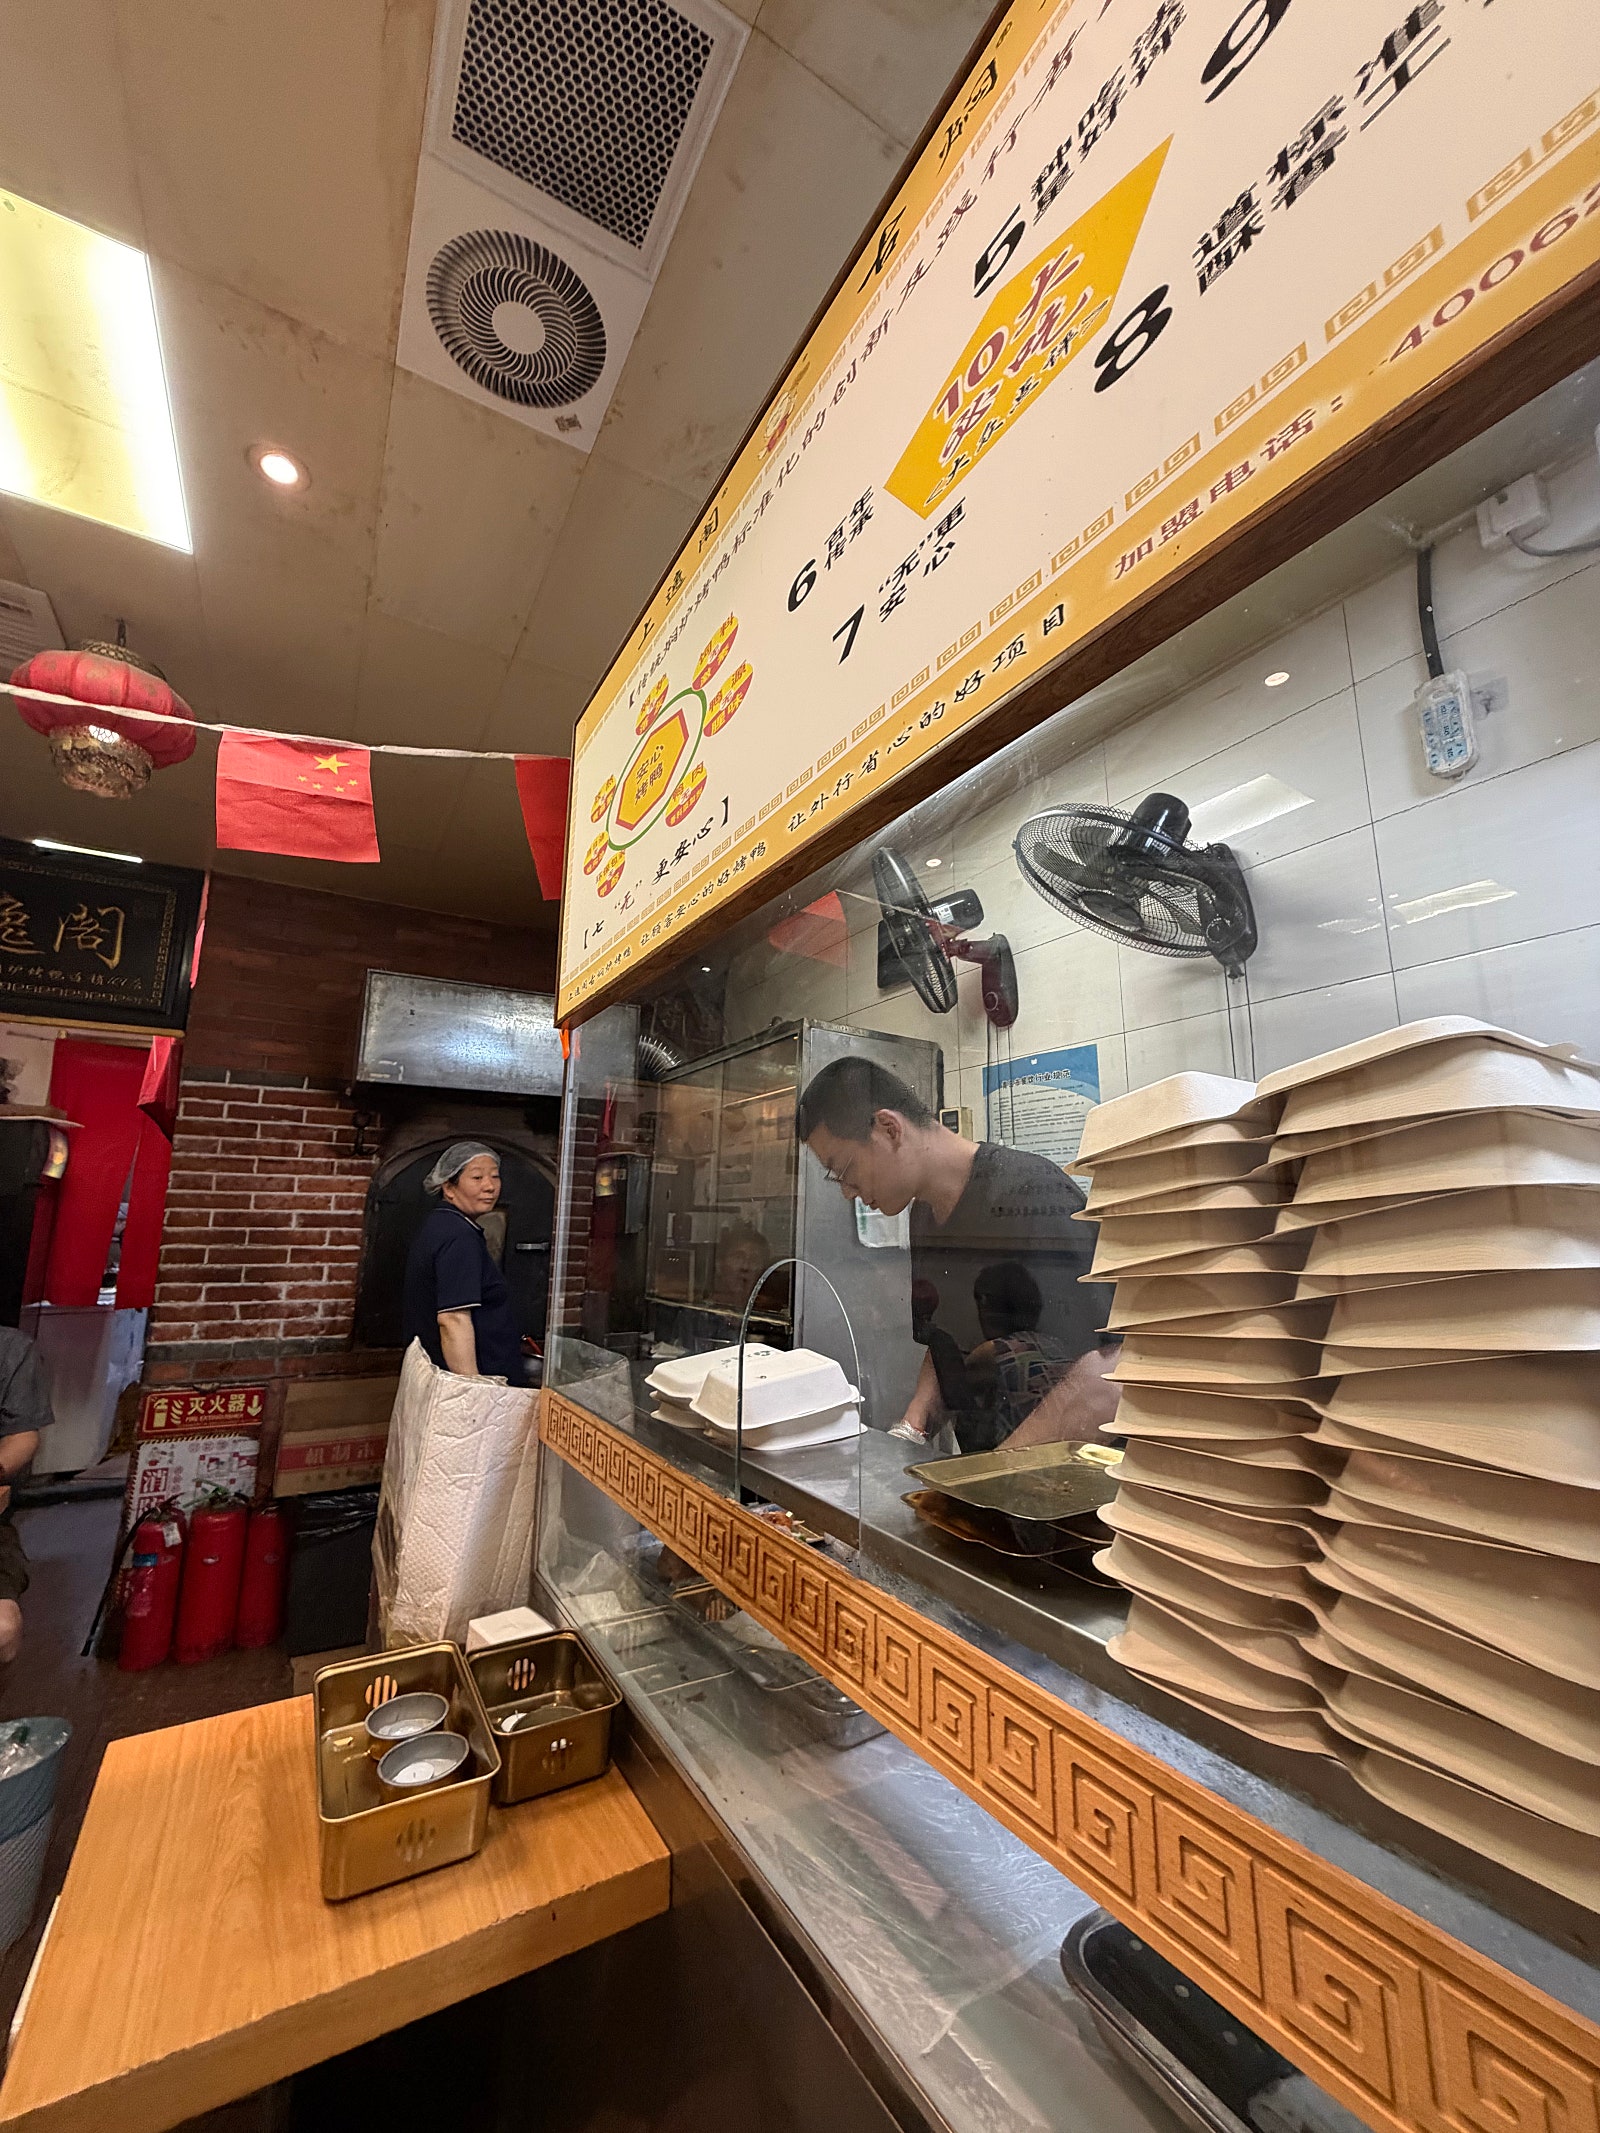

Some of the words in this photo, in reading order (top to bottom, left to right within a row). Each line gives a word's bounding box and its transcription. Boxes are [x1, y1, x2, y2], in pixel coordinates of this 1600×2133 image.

[1200, 0, 1291, 104] 9
[1197, 0, 1495, 296] 酥香工
[974, 203, 1026, 298] 5
[940, 287, 1093, 466] 必吃
[1094, 284, 1173, 393] 8
[788, 558, 817, 613] 6
[832, 604, 865, 665] 7
[187, 1393, 246, 1416] 灭火器
